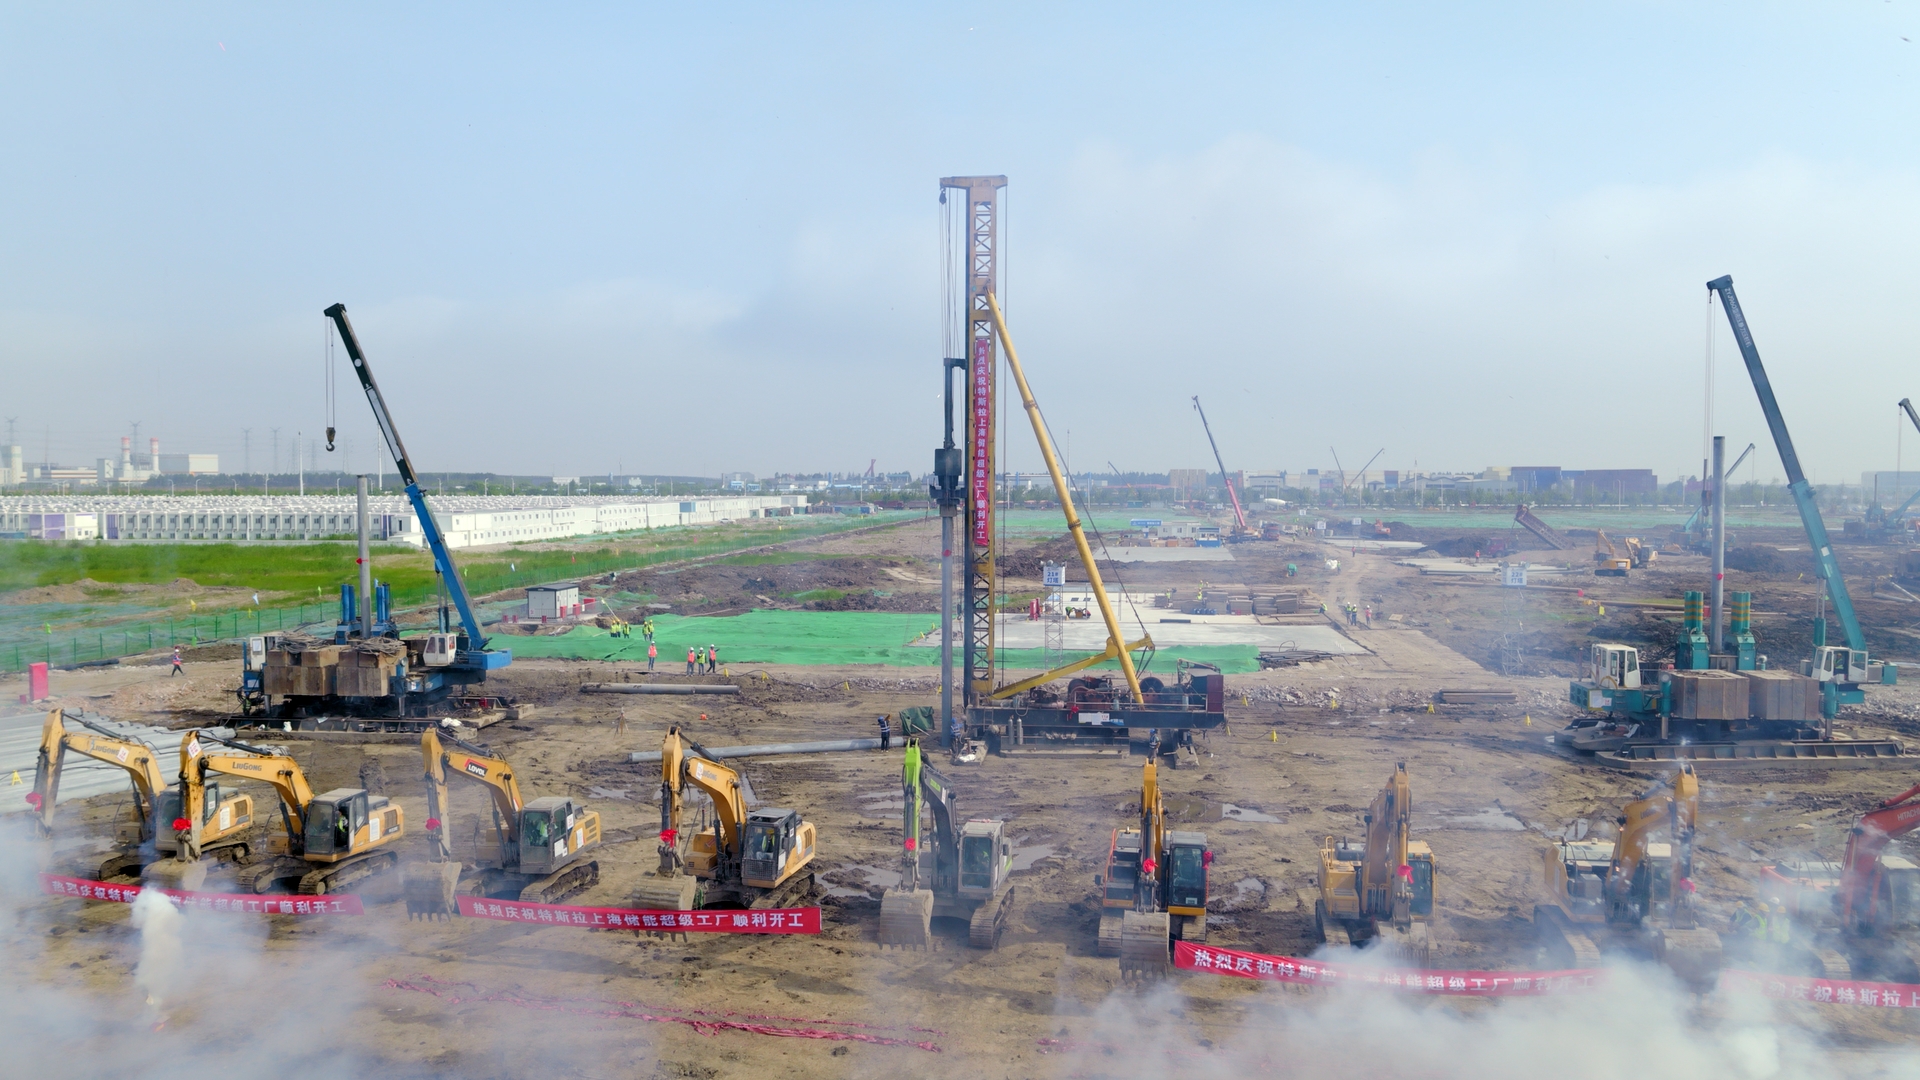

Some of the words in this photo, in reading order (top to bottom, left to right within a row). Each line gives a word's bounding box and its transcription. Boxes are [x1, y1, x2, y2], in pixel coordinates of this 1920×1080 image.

[976, 346, 987, 539] 热烈庆祝特斯拉上海储能超级工厂顺利开工
[468, 764, 486, 776] LOVOL
[51, 880, 346, 914] 热烈庆祝特斯海储能超级工厂顺利开工
[473, 902, 804, 928] 热烈庆祝特斯拉上海储能超级工厂顺利开工
[1747, 978, 1920, 1007] 烈庆祝特斯拉上
